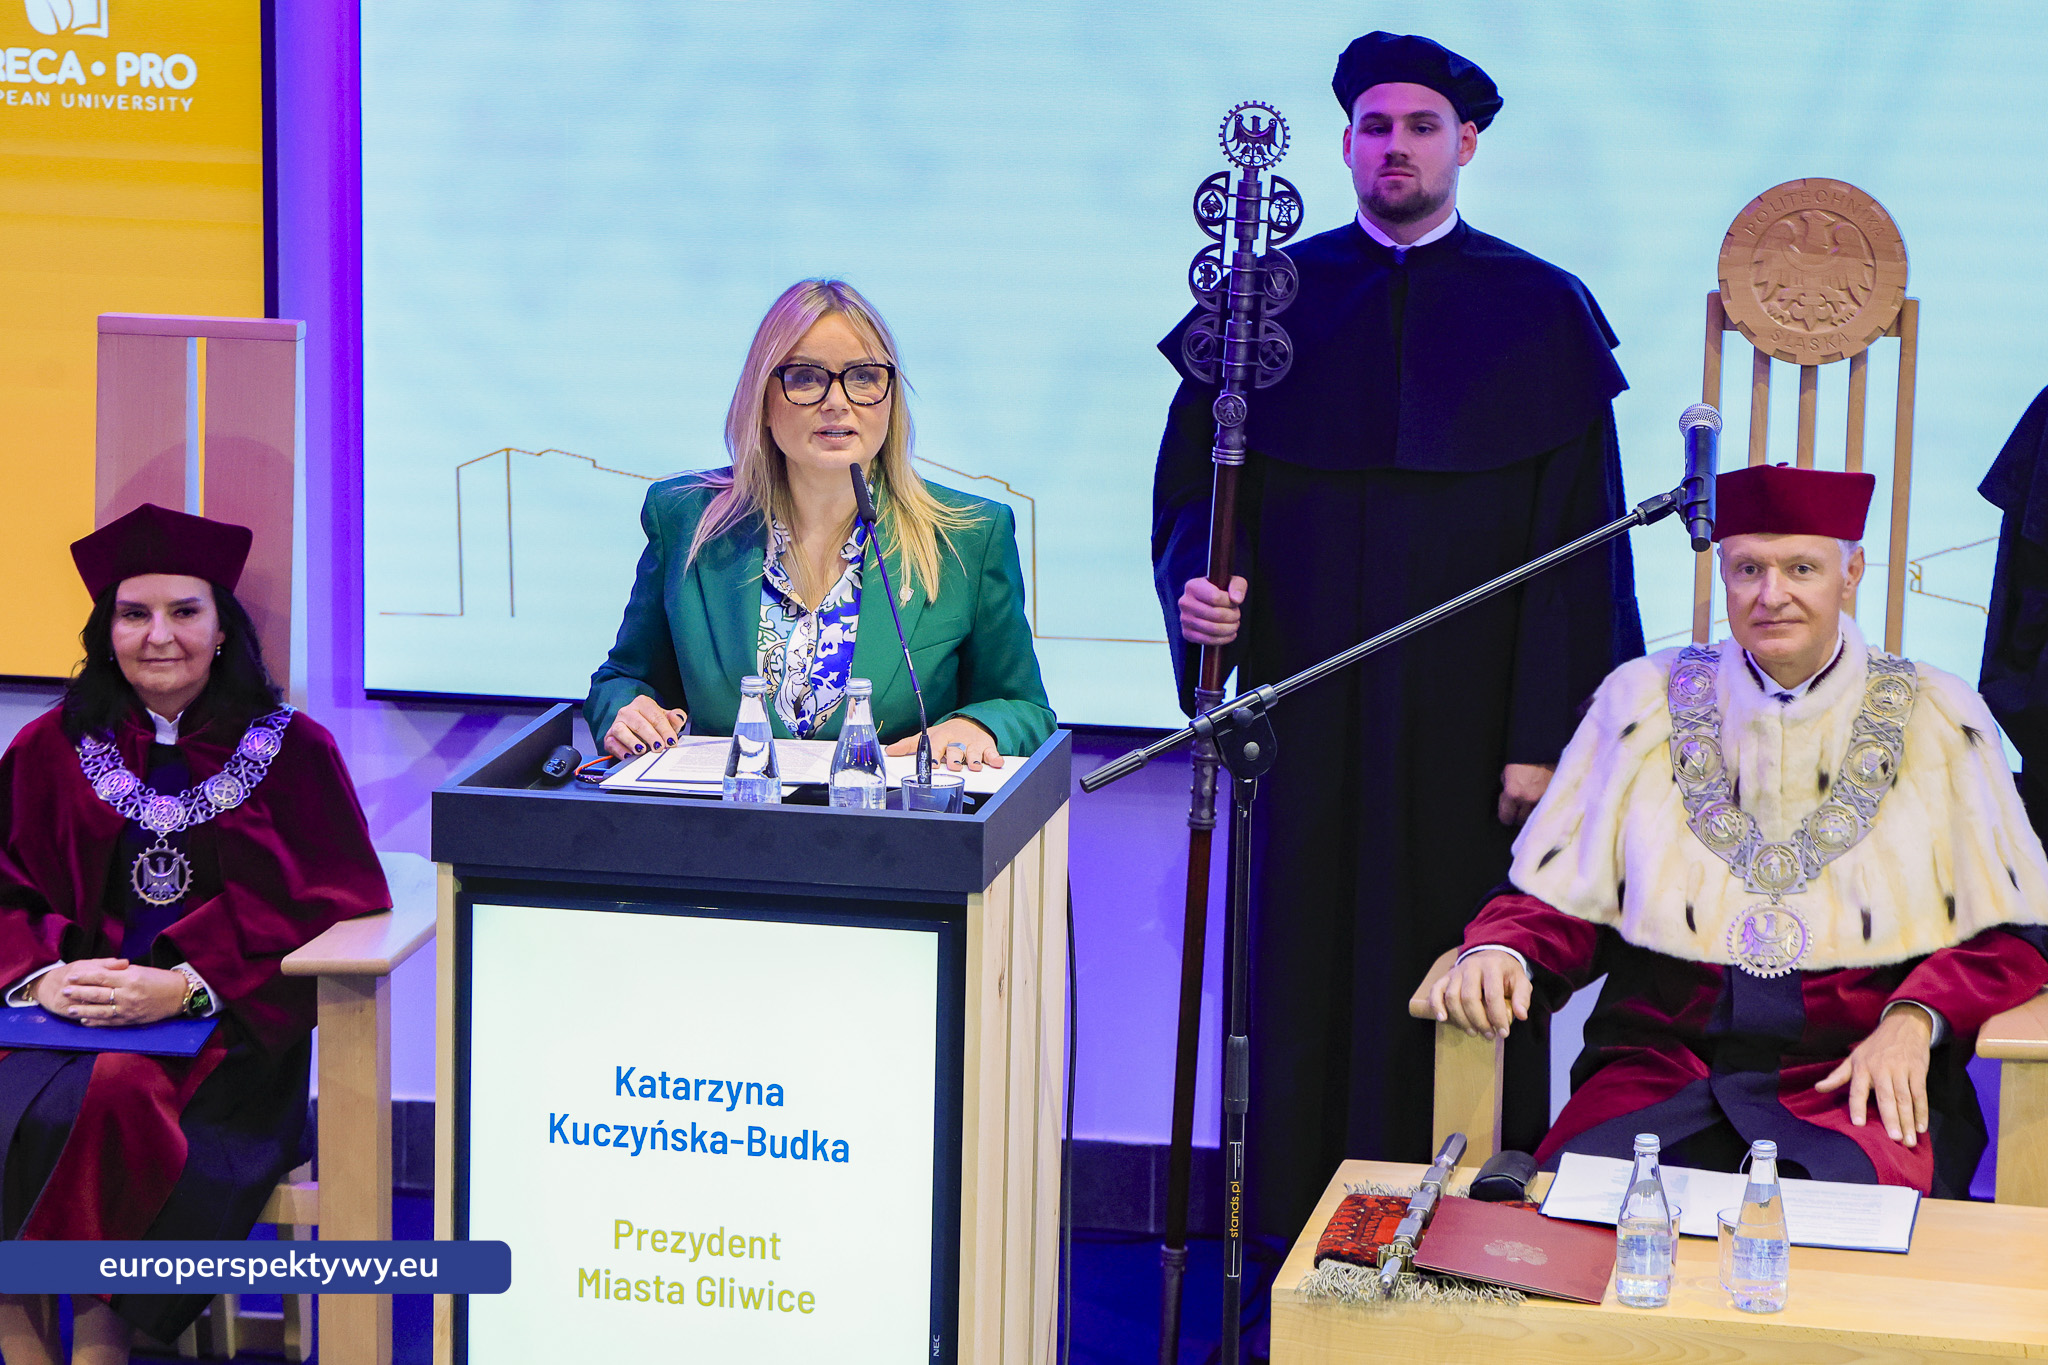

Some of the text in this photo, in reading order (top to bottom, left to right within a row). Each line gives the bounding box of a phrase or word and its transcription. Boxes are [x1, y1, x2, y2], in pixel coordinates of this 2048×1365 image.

[0, 47, 197, 90] ECA PRO
[60, 92, 193, 112] UNIVERSITY
[615, 1065, 784, 1112] Katarzyna
[549, 1112, 850, 1164] Kuczyńska-Budka
[1229, 1181, 1241, 1238] stands.pl
[613, 1219, 782, 1263] Prezydent
[578, 1267, 816, 1315] Miasta Gliwice
[932, 1334, 941, 1357] NEC
